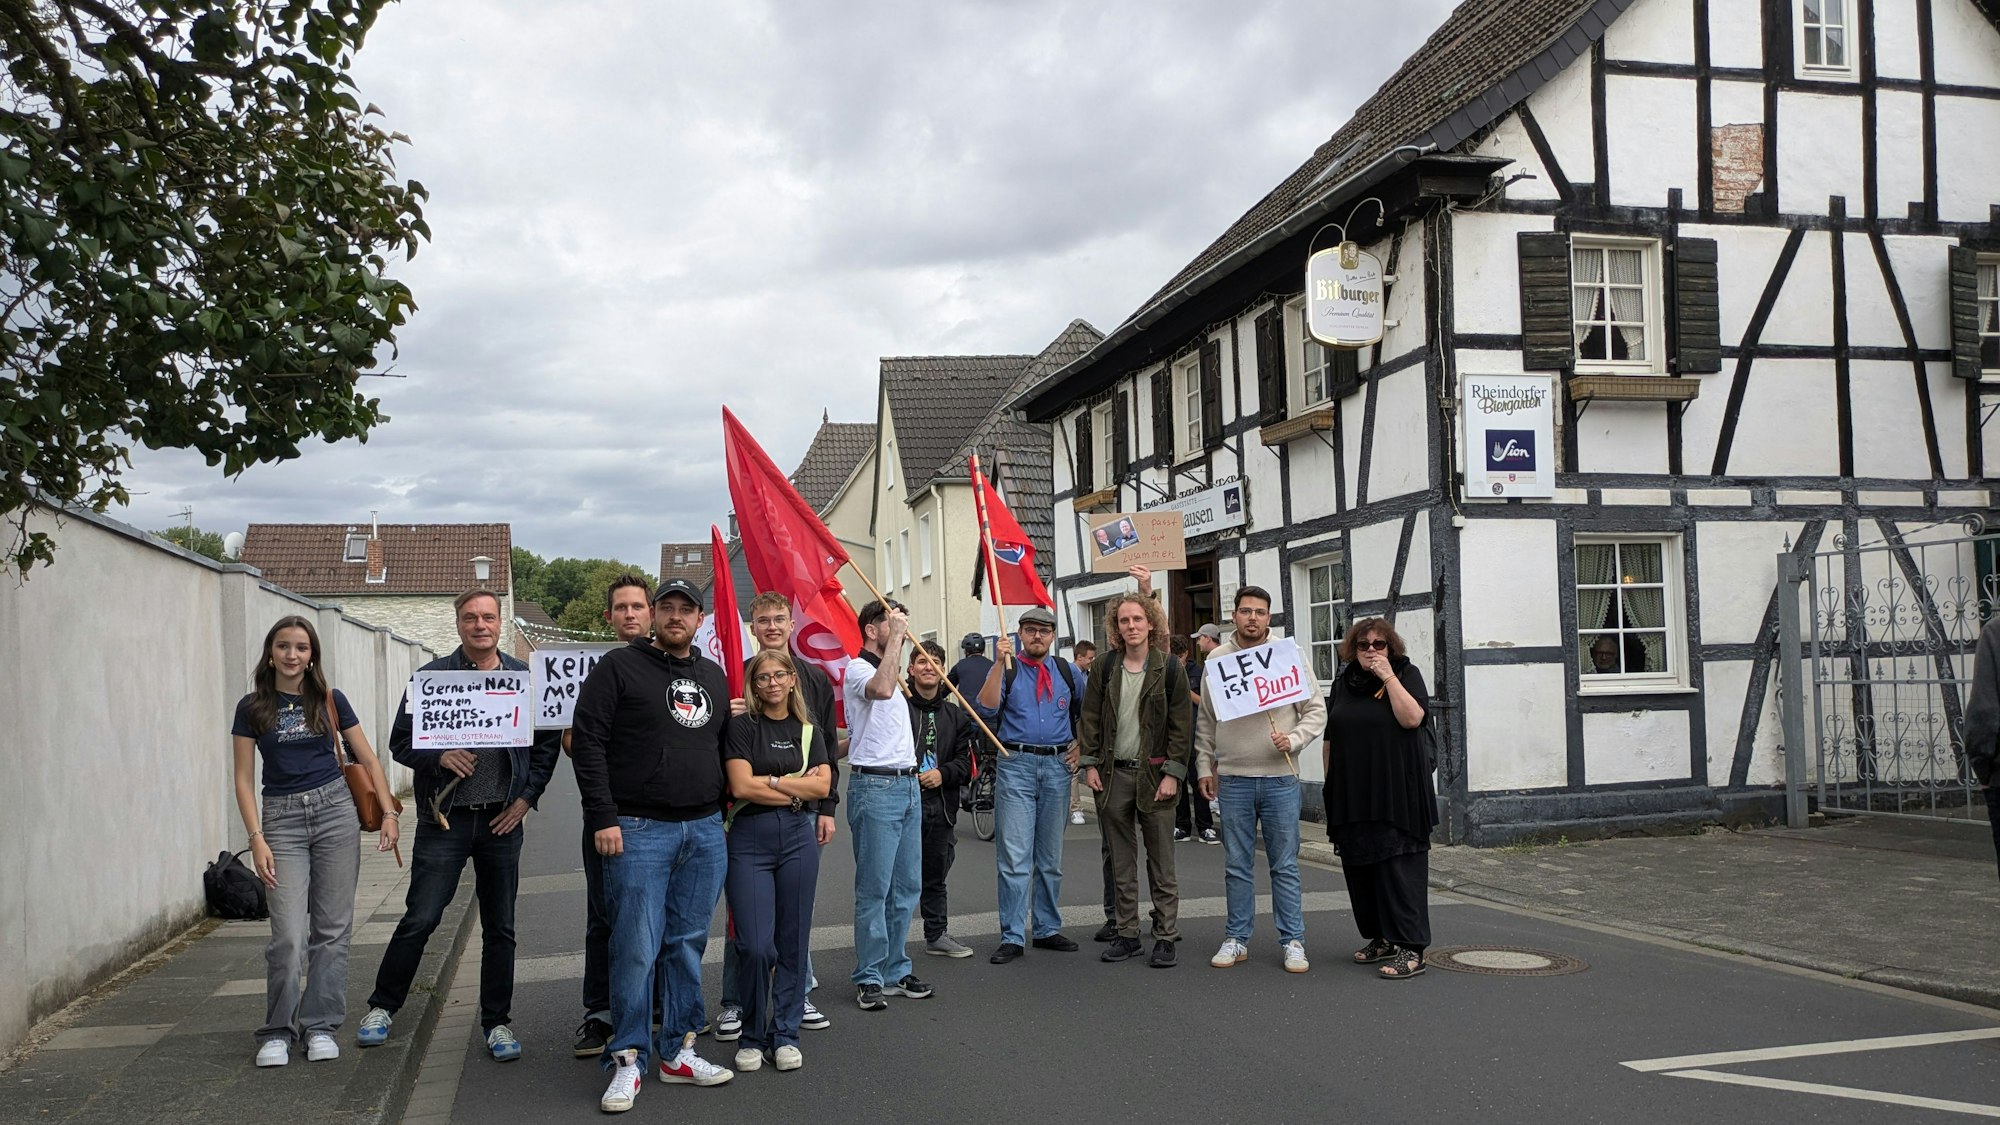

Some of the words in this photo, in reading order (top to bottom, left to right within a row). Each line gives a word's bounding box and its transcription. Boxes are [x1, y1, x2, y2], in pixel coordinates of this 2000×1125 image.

[1315, 279, 1380, 305] Bitburger
[1471, 384, 1547, 399] Rheindorfer
[1477, 394, 1542, 416] Biergarten
[1491, 439, 1531, 462] Sion
[1170, 497, 1198, 511] GASTSTÄTTE
[1183, 507, 1214, 528] ausen
[1150, 533, 1167, 546] gut
[1217, 647, 1273, 683] LEV
[467, 682, 482, 691] ein
[543, 681, 583, 702] Me
[1223, 678, 1249, 700] ist
[1254, 665, 1300, 703] Bunt
[421, 699, 453, 709] gerne
[455, 698, 472, 706] ein
[543, 701, 562, 718] ist
[422, 708, 486, 722] RECHTS-
[671, 709, 711, 727] ANTI-FASCIST
